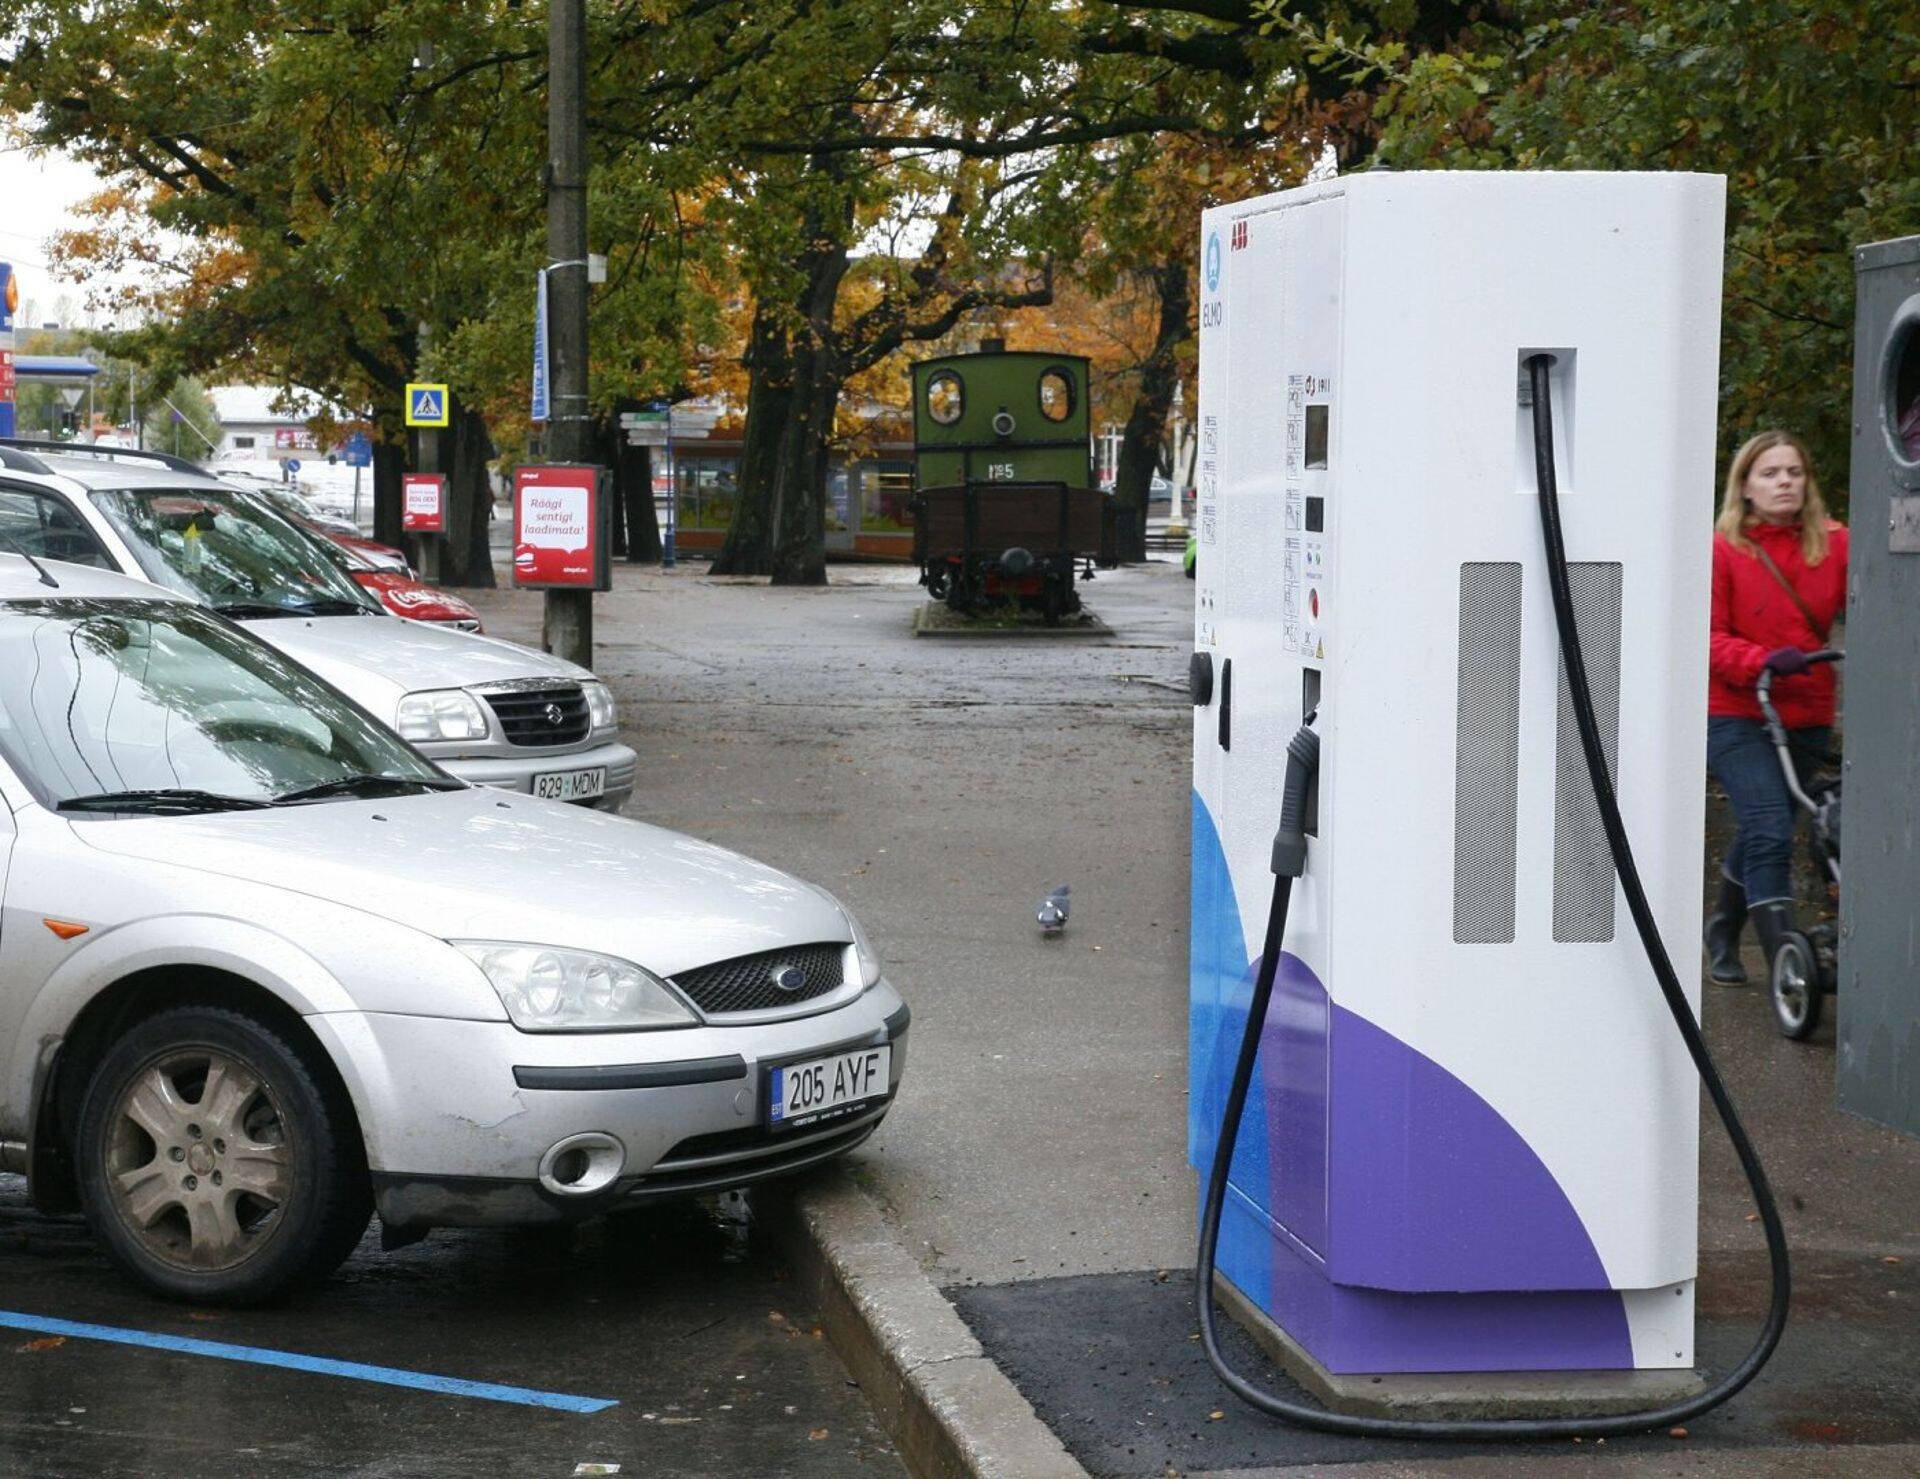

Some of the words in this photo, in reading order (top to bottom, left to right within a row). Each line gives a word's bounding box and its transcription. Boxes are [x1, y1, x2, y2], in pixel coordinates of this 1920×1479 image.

[1231, 221, 1248, 252] ABB
[1203, 302, 1222, 328] ELMO
[536, 512, 573, 524] sentigi
[539, 776, 563, 799] 829
[571, 771, 600, 796] MDM
[789, 1066, 824, 1111] 205
[833, 1053, 879, 1101] AYF
